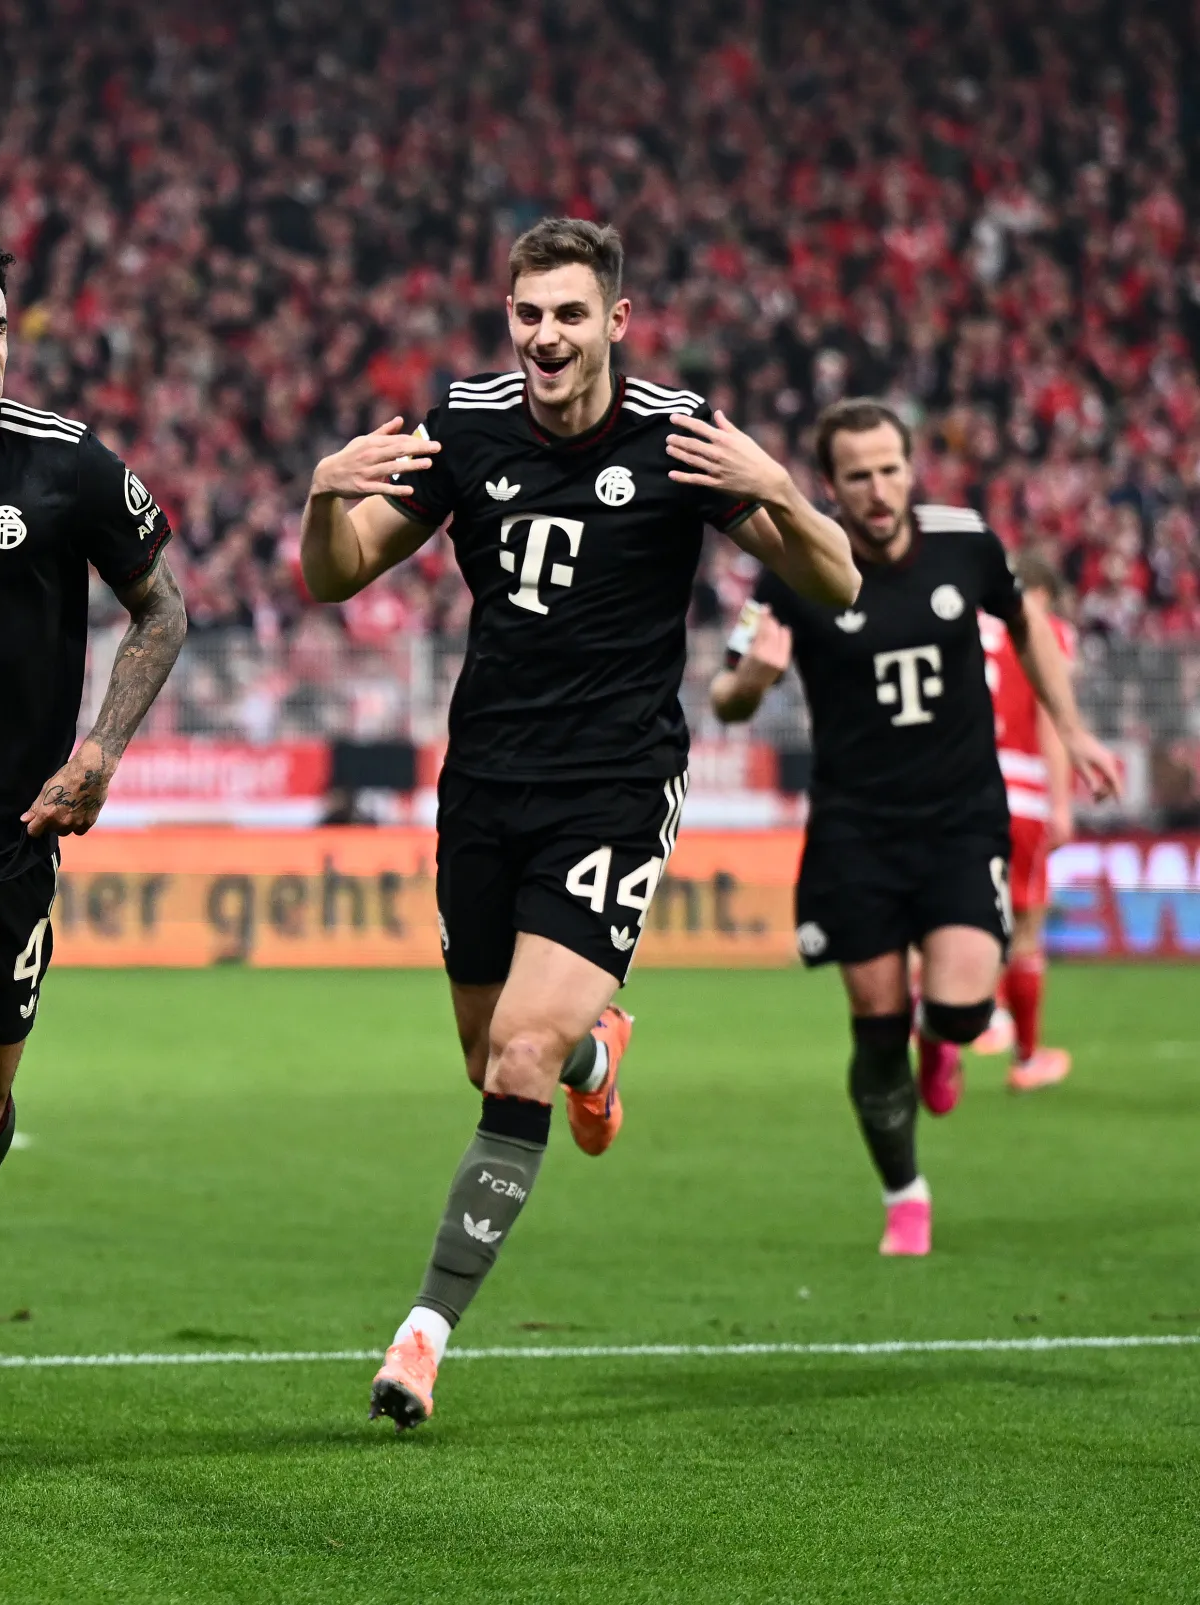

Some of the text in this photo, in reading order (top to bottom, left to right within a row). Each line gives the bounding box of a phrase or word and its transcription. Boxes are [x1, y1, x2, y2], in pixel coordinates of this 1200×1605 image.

[499, 512, 585, 615] T
[873, 644, 944, 727] T
[565, 845, 663, 928] 44
[478, 1170, 527, 1203] FCBM
